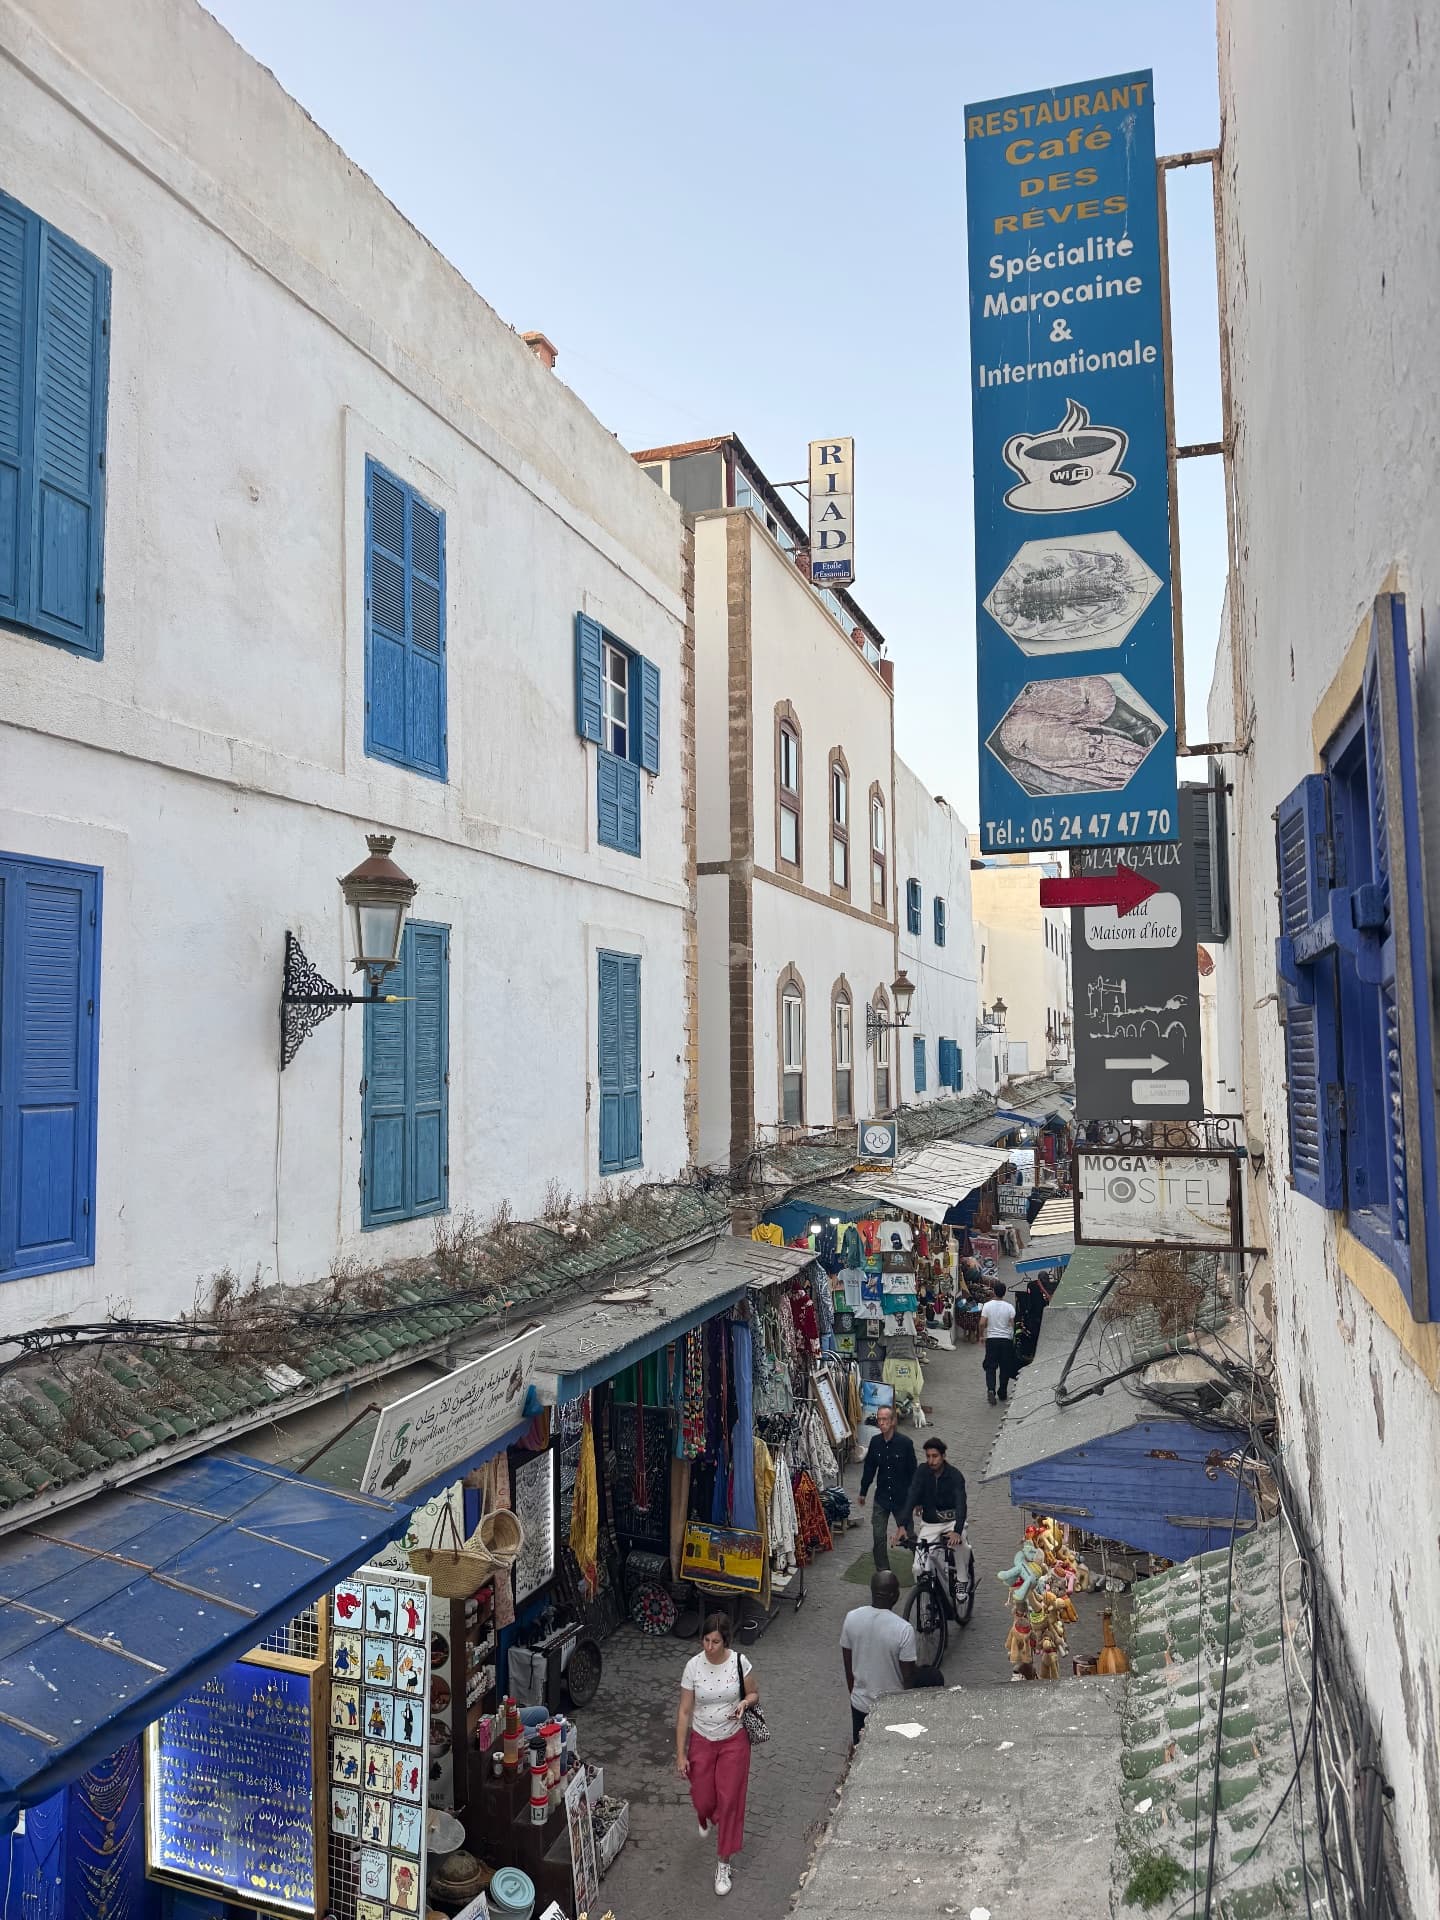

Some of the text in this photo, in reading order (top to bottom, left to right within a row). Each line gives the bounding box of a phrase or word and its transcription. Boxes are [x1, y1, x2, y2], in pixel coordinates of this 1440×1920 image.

[968, 82, 1149, 139] RESTAURANT
[1005, 124, 1112, 166] Café
[1020, 167, 1099, 198] DES
[988, 232, 1135, 282] Spécialité
[983, 275, 1143, 318] Marocaine
[1049, 318, 1074, 343] &
[979, 340, 1158, 388] Internationale
[816, 444, 848, 551] RIAD
[1031, 817, 1054, 843] 05
[1060, 815, 1082, 840] 24
[1088, 813, 1111, 838] 47
[1117, 811, 1141, 836] 47
[1147, 809, 1171, 835] 70
[1082, 843, 1183, 870] MARGAUX
[1090, 924, 1136, 941] Maison
[1085, 1176, 1225, 1206] HOSTEL
